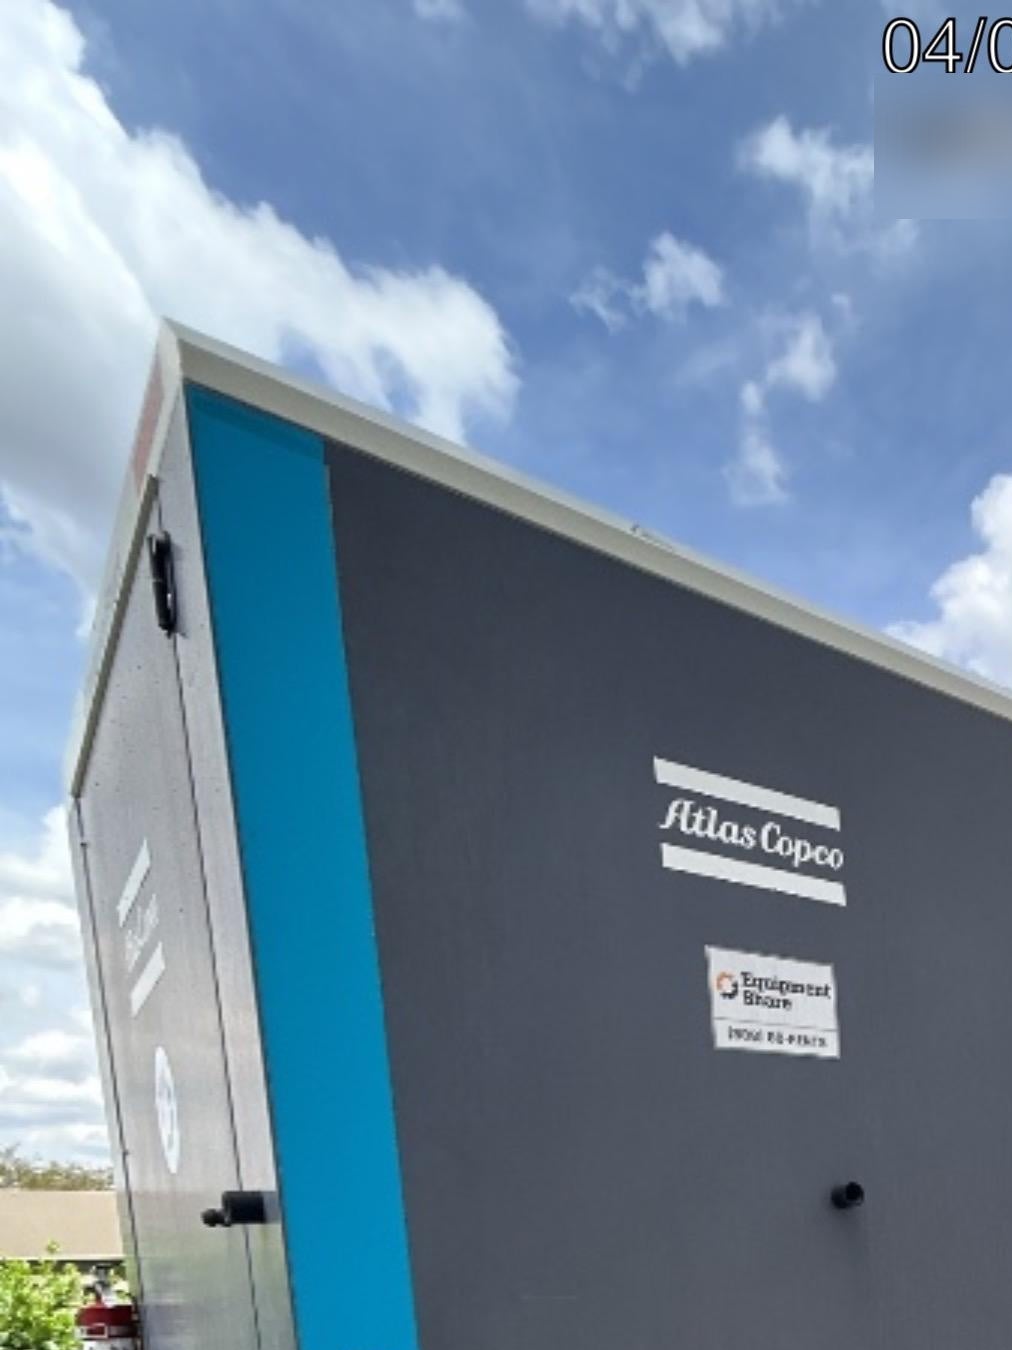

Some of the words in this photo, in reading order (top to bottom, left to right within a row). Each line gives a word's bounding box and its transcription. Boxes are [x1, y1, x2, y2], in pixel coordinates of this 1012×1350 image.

[659, 798, 757, 849] Atlas
[760, 820, 844, 870] Copco
[741, 970, 831, 999] Equipment
[743, 989, 793, 1011] Share
